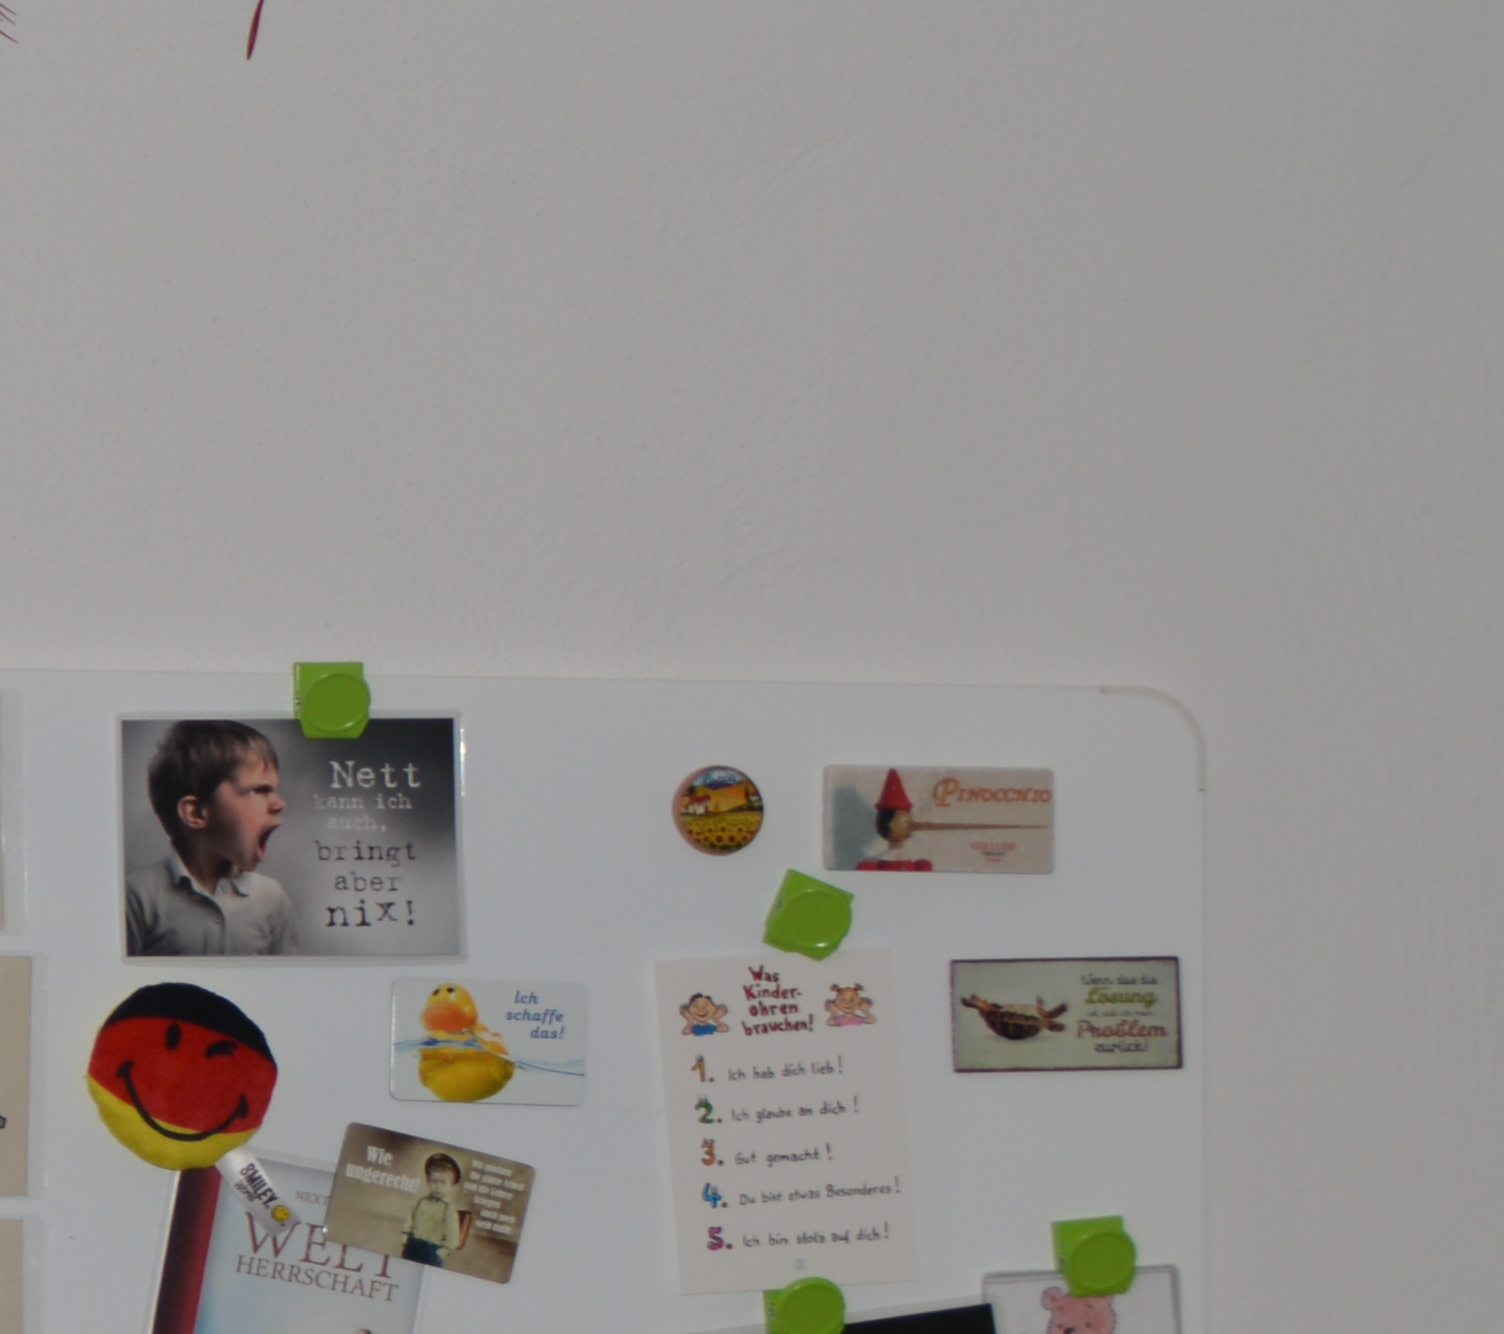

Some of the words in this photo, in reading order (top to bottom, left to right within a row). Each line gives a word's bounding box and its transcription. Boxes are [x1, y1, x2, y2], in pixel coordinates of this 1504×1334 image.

[330, 761, 420, 788] Nett
[314, 794, 364, 809] kann
[376, 793, 414, 809] ich
[932, 777, 1054, 808] PINOCCHIO
[327, 814, 387, 832] auch,
[314, 840, 417, 868] bringt
[334, 871, 402, 892] aber
[326, 899, 415, 927] nix!
[748, 964, 780, 983] Was
[514, 989, 538, 1005] Ich
[743, 982, 803, 1001] Kinder-
[505, 1008, 564, 1025] schaffe
[749, 999, 799, 1017] ohren
[529, 1026, 566, 1040] das!
[741, 1013, 814, 1037] brauchen!
[690, 1054, 715, 1083] 1.
[728, 1068, 746, 1081] Ich
[752, 1066, 775, 1079] hab
[781, 1063, 806, 1078] dich
[694, 1095, 723, 1124] 2.
[731, 1109, 750, 1122] Ich
[755, 1107, 792, 1123] glaube
[798, 1107, 813, 1116] an
[366, 1145, 394, 1166] Wie
[700, 1138, 724, 1166] 3.
[734, 1150, 757, 1165] Gut
[345, 1163, 421, 1195] ungerecht!
[702, 1182, 728, 1209] 4.
[739, 1193, 756, 1206] Du
[761, 1191, 782, 1203] bist
[788, 1188, 820, 1201] etwas
[706, 1226, 733, 1251] 5.
[742, 1235, 760, 1248] Ich
[768, 1233, 789, 1246] bin
[796, 1230, 826, 1245] stolz
[830, 1230, 850, 1245] auf
[235, 1254, 400, 1302] HERRSCHAFT
